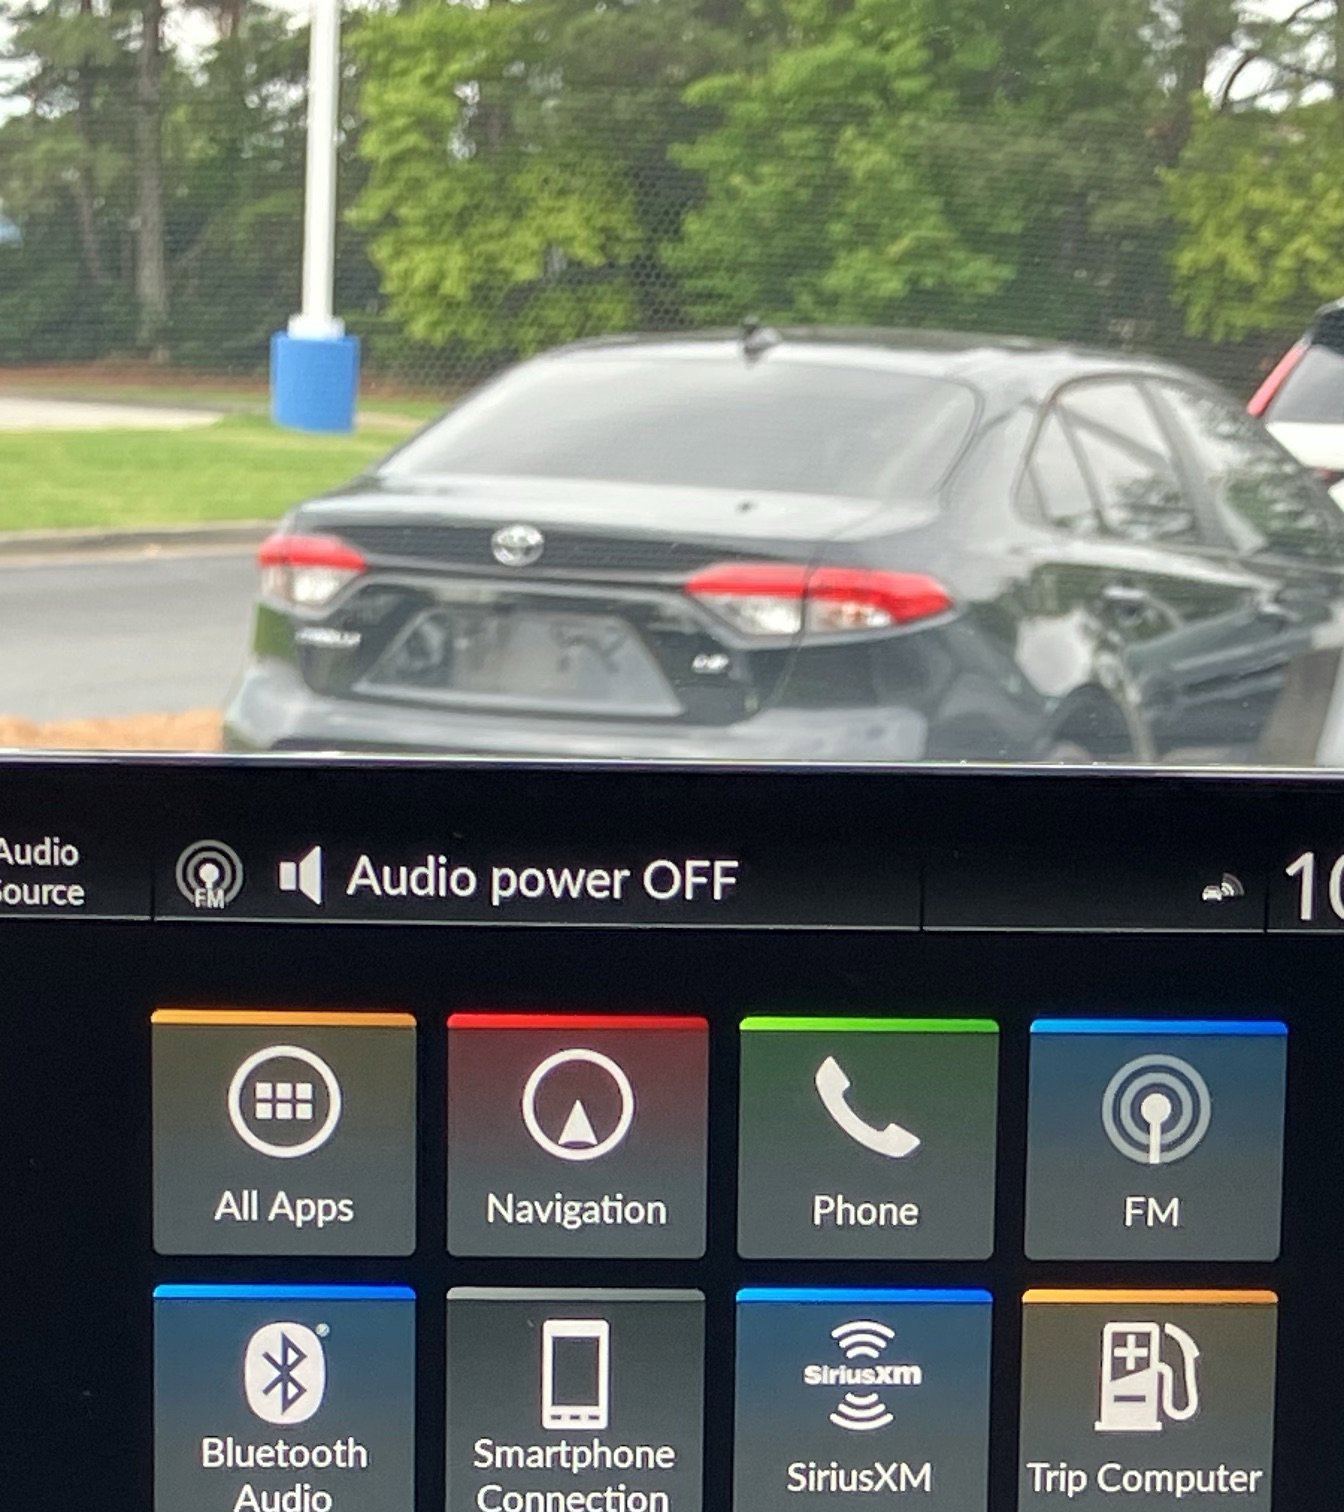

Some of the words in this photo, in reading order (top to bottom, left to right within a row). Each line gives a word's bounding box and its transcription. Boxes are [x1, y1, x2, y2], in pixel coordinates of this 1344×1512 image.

[346, 854, 477, 897] Audio
[492, 866, 631, 906] power
[643, 859, 739, 901] OFF
[214, 1189, 258, 1221] All
[268, 1190, 354, 1228] Apps
[487, 1192, 667, 1230] Navigation
[813, 1194, 919, 1226] Phone
[1125, 1196, 1179, 1227] FM
[202, 1436, 368, 1468] Bluetooth
[473, 1437, 675, 1474] Smartphone
[787, 1461, 932, 1492] SiriusXM
[1026, 1462, 1088, 1498] Trip
[1097, 1462, 1263, 1498] Computer
